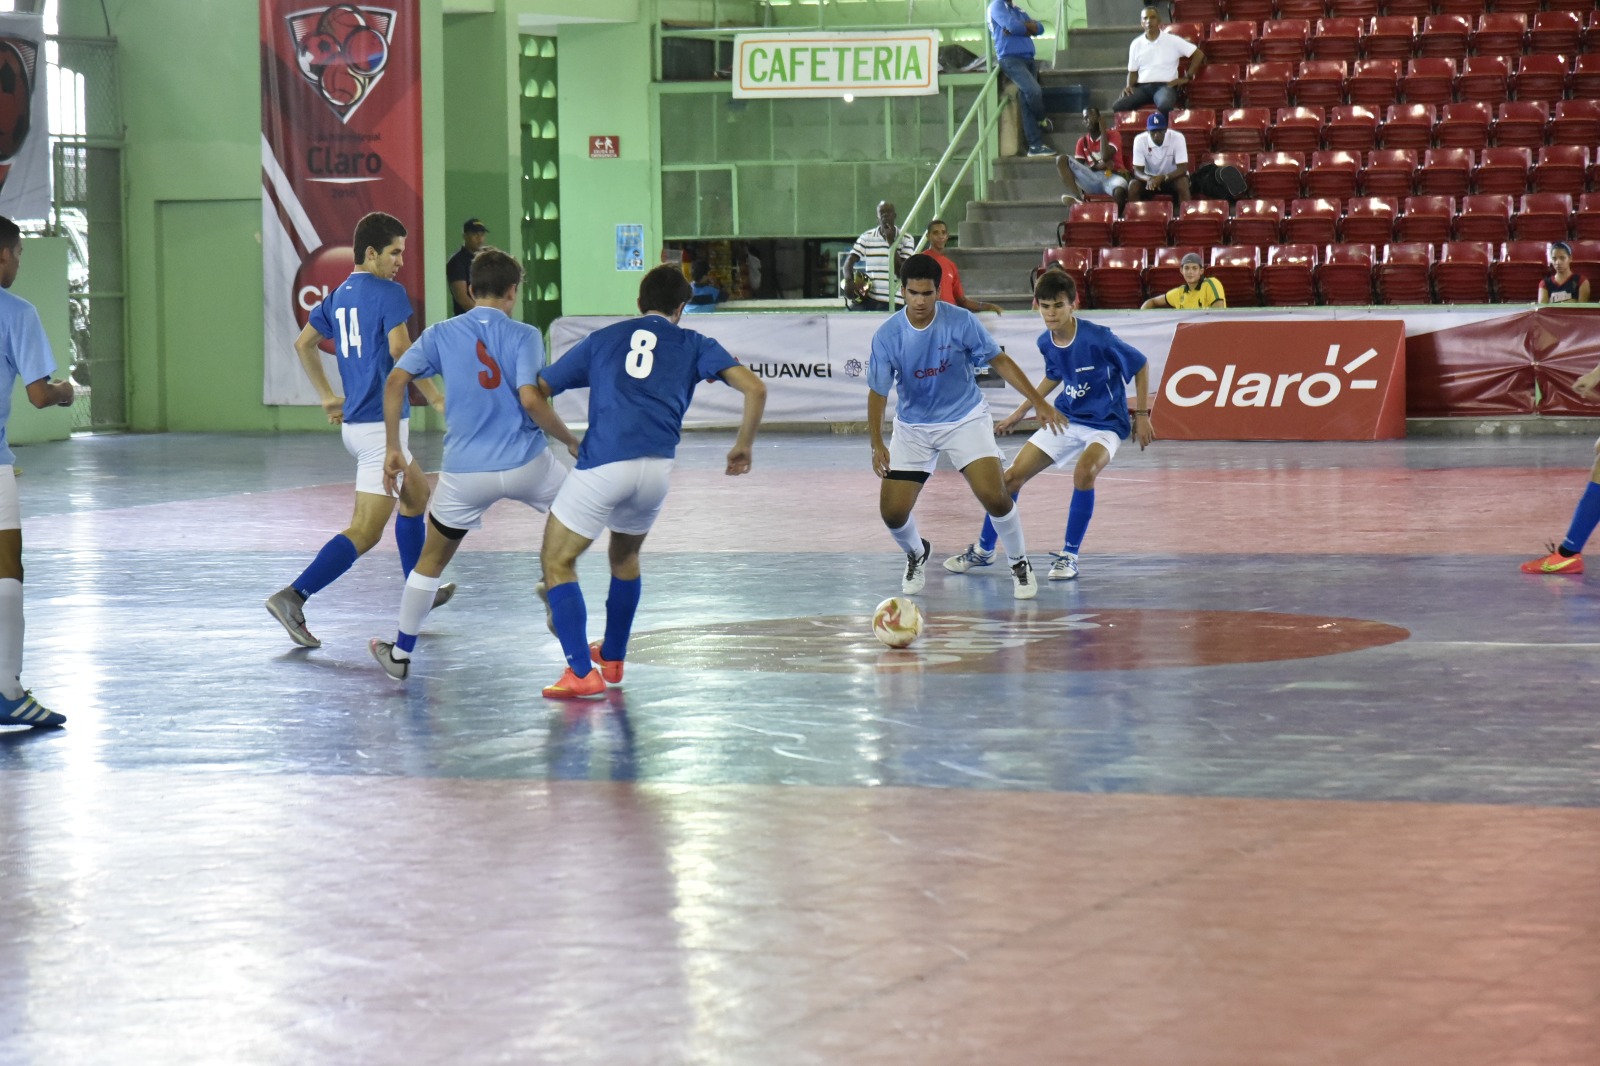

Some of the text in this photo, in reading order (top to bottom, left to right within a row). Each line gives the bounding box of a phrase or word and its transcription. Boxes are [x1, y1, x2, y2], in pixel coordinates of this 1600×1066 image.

[748, 45, 922, 82] CAFETERIA
[307, 146, 382, 175] Claro
[335, 307, 362, 358] 14
[625, 329, 658, 379] 8
[749, 363, 832, 378] HUAWEI
[914, 364, 948, 380] Claro
[1165, 364, 1342, 408] Claro
